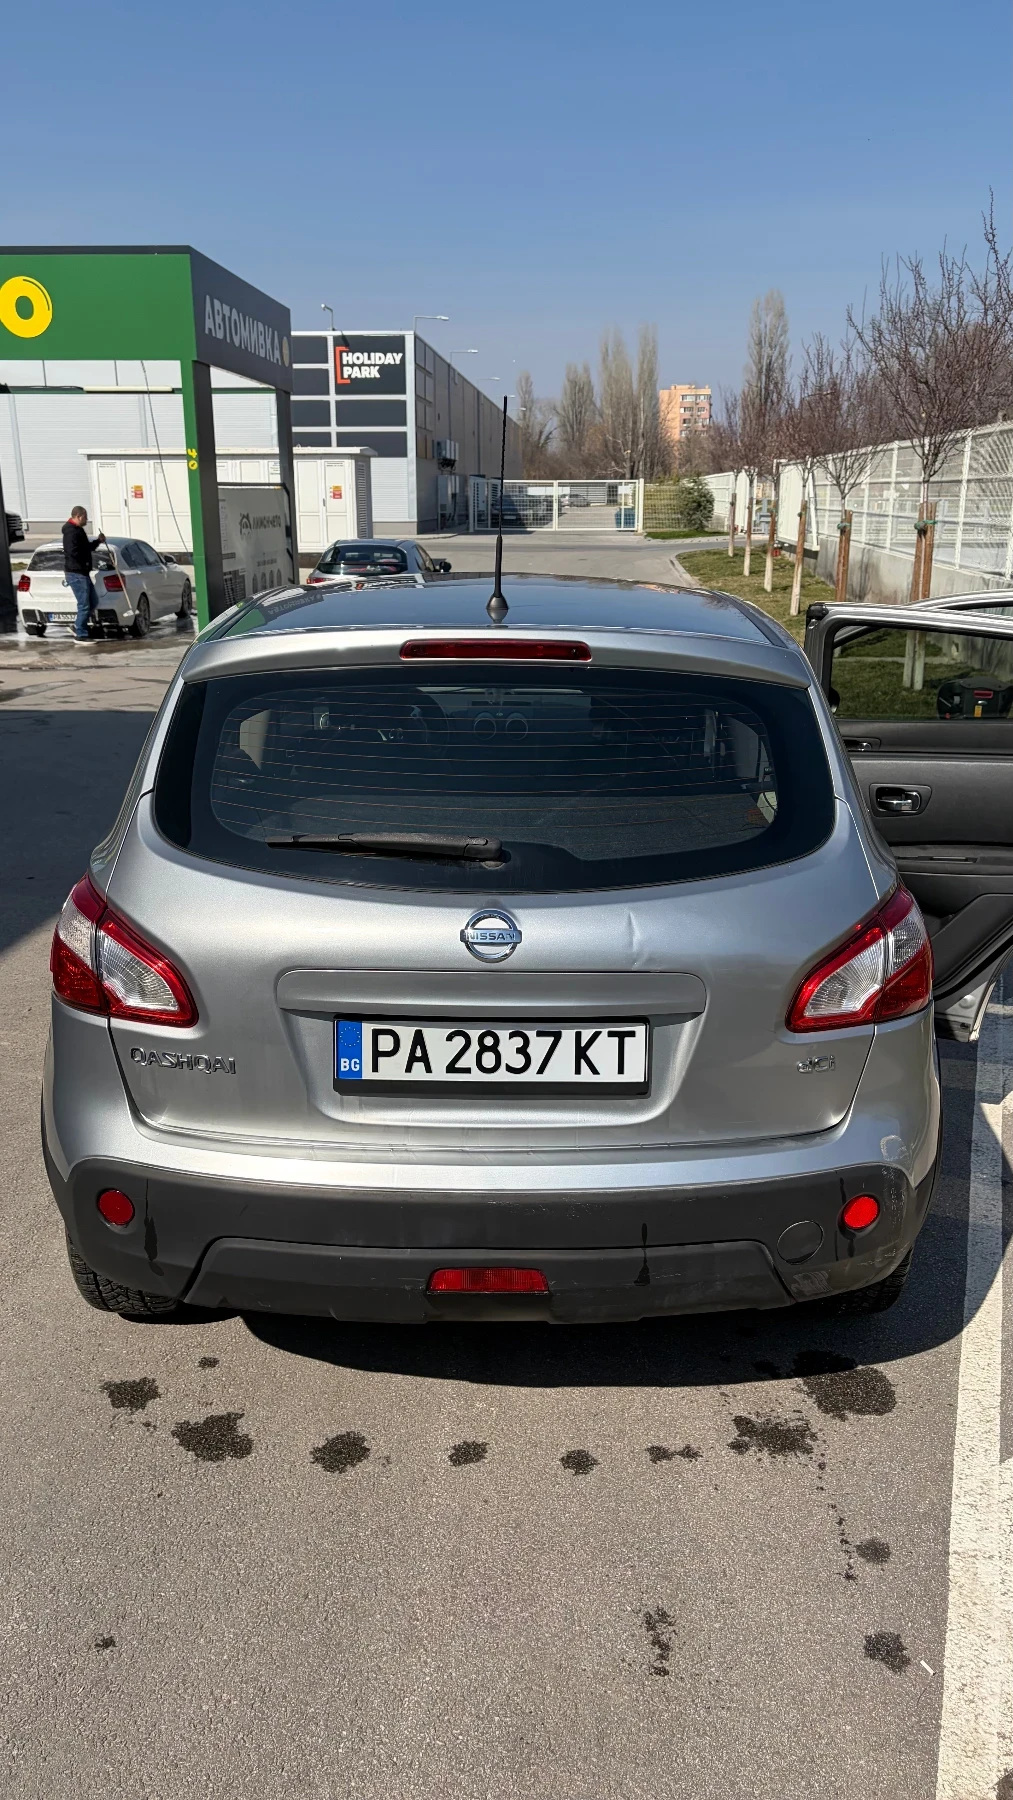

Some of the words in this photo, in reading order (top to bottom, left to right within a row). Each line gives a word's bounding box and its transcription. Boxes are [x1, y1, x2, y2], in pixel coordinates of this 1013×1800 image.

[204, 294, 282, 366] АВТОМИВКА
[341, 352, 403, 365] HOLIDAY
[343, 366, 381, 379] PARK
[465, 932, 516, 941] NISSAN
[371, 1028, 433, 1074] PA
[445, 1029, 562, 1075] 2837
[574, 1030, 636, 1076] KT
[130, 1047, 237, 1075] QASHQAI
[340, 1058, 360, 1072] BG
